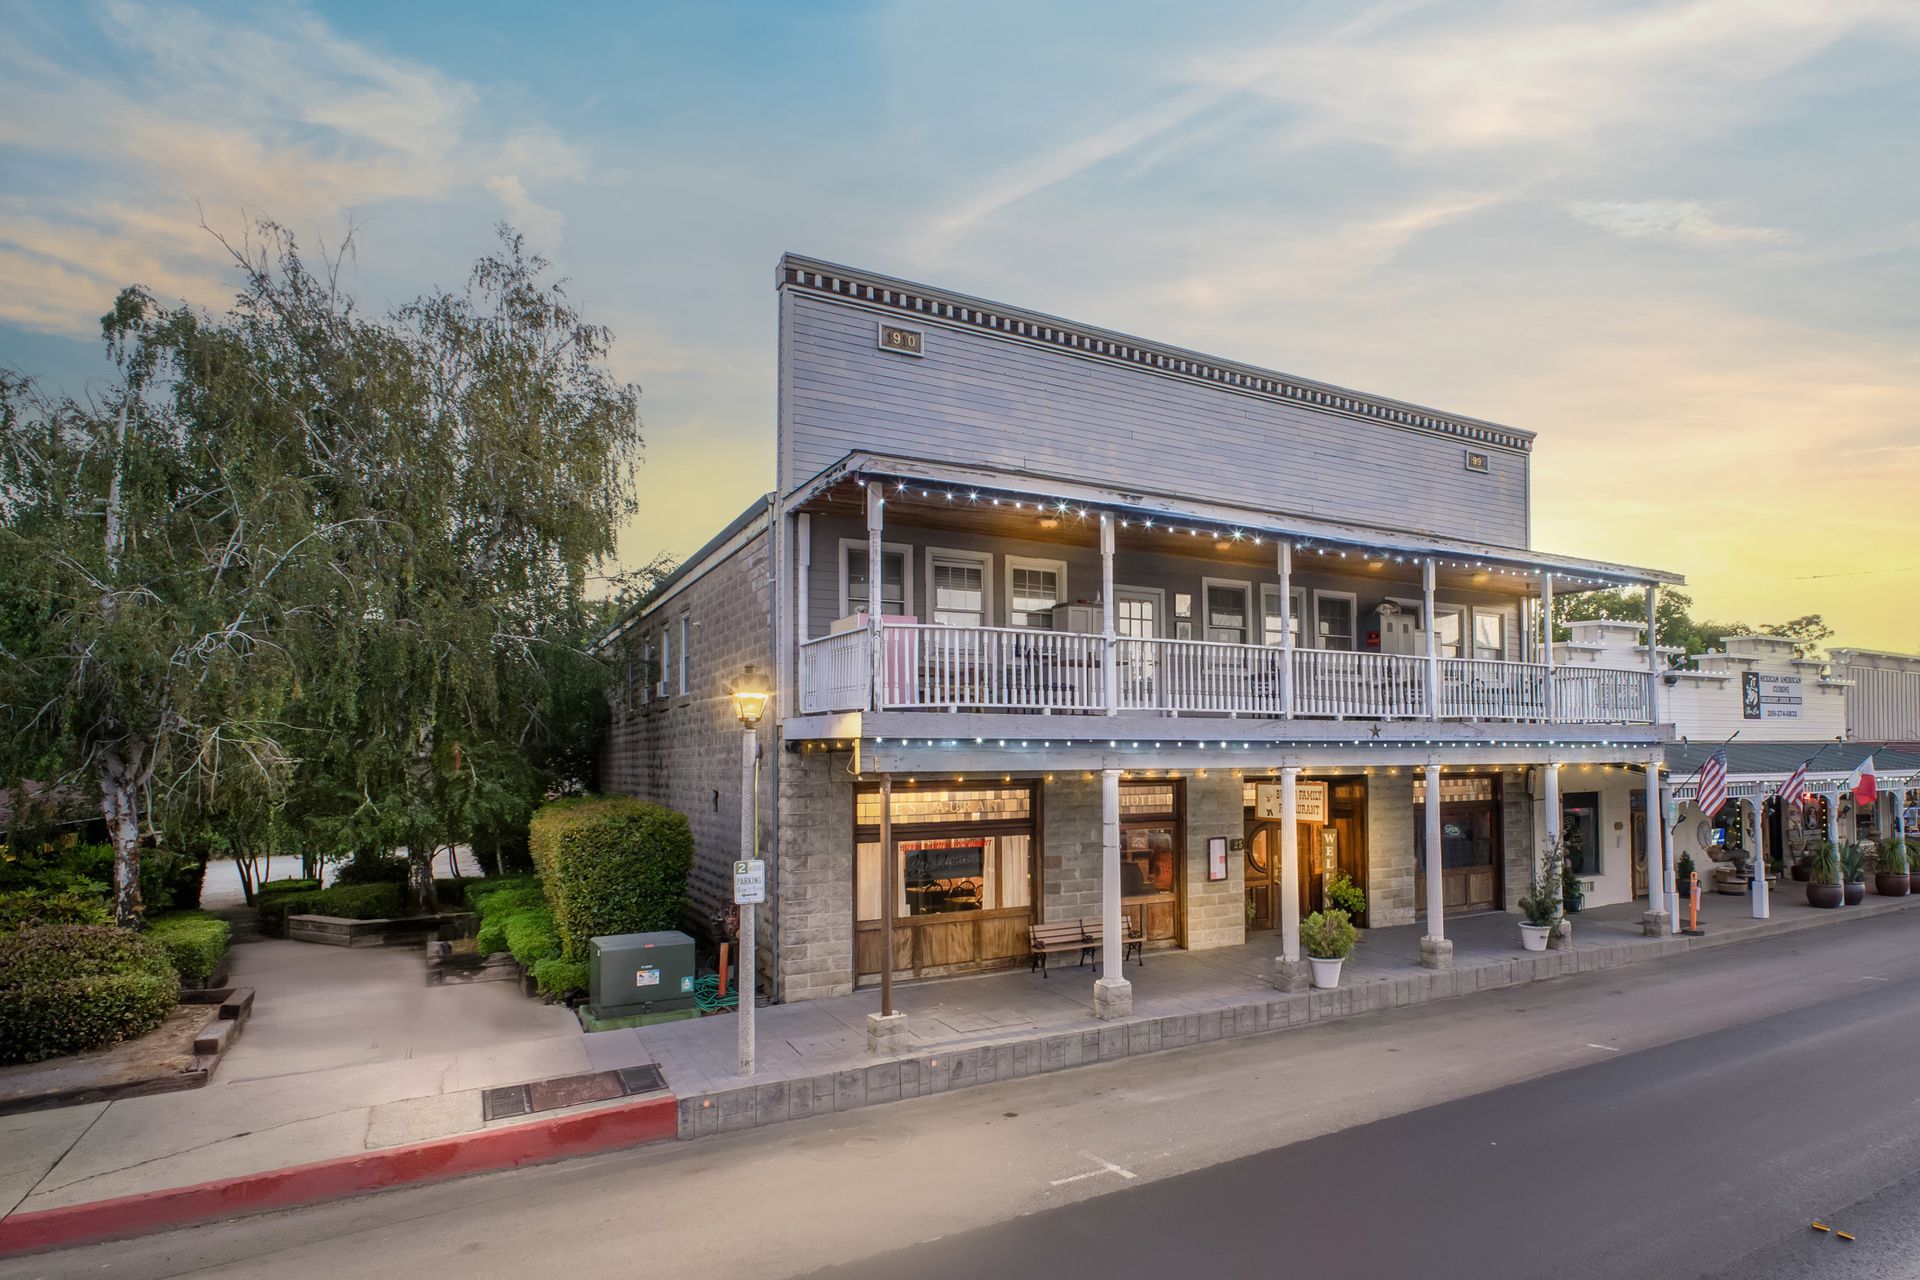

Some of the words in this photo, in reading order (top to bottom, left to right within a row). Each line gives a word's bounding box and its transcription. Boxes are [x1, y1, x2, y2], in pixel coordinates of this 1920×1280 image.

[1760, 675, 1779, 683] MEXICAN
[1780, 676, 1801, 684] AMERICAN
[1122, 795, 1165, 806] HOTEL
[1299, 790, 1322, 801] FAMILY
[738, 863, 746, 873] 2
[736, 876, 762, 886] PARKING
